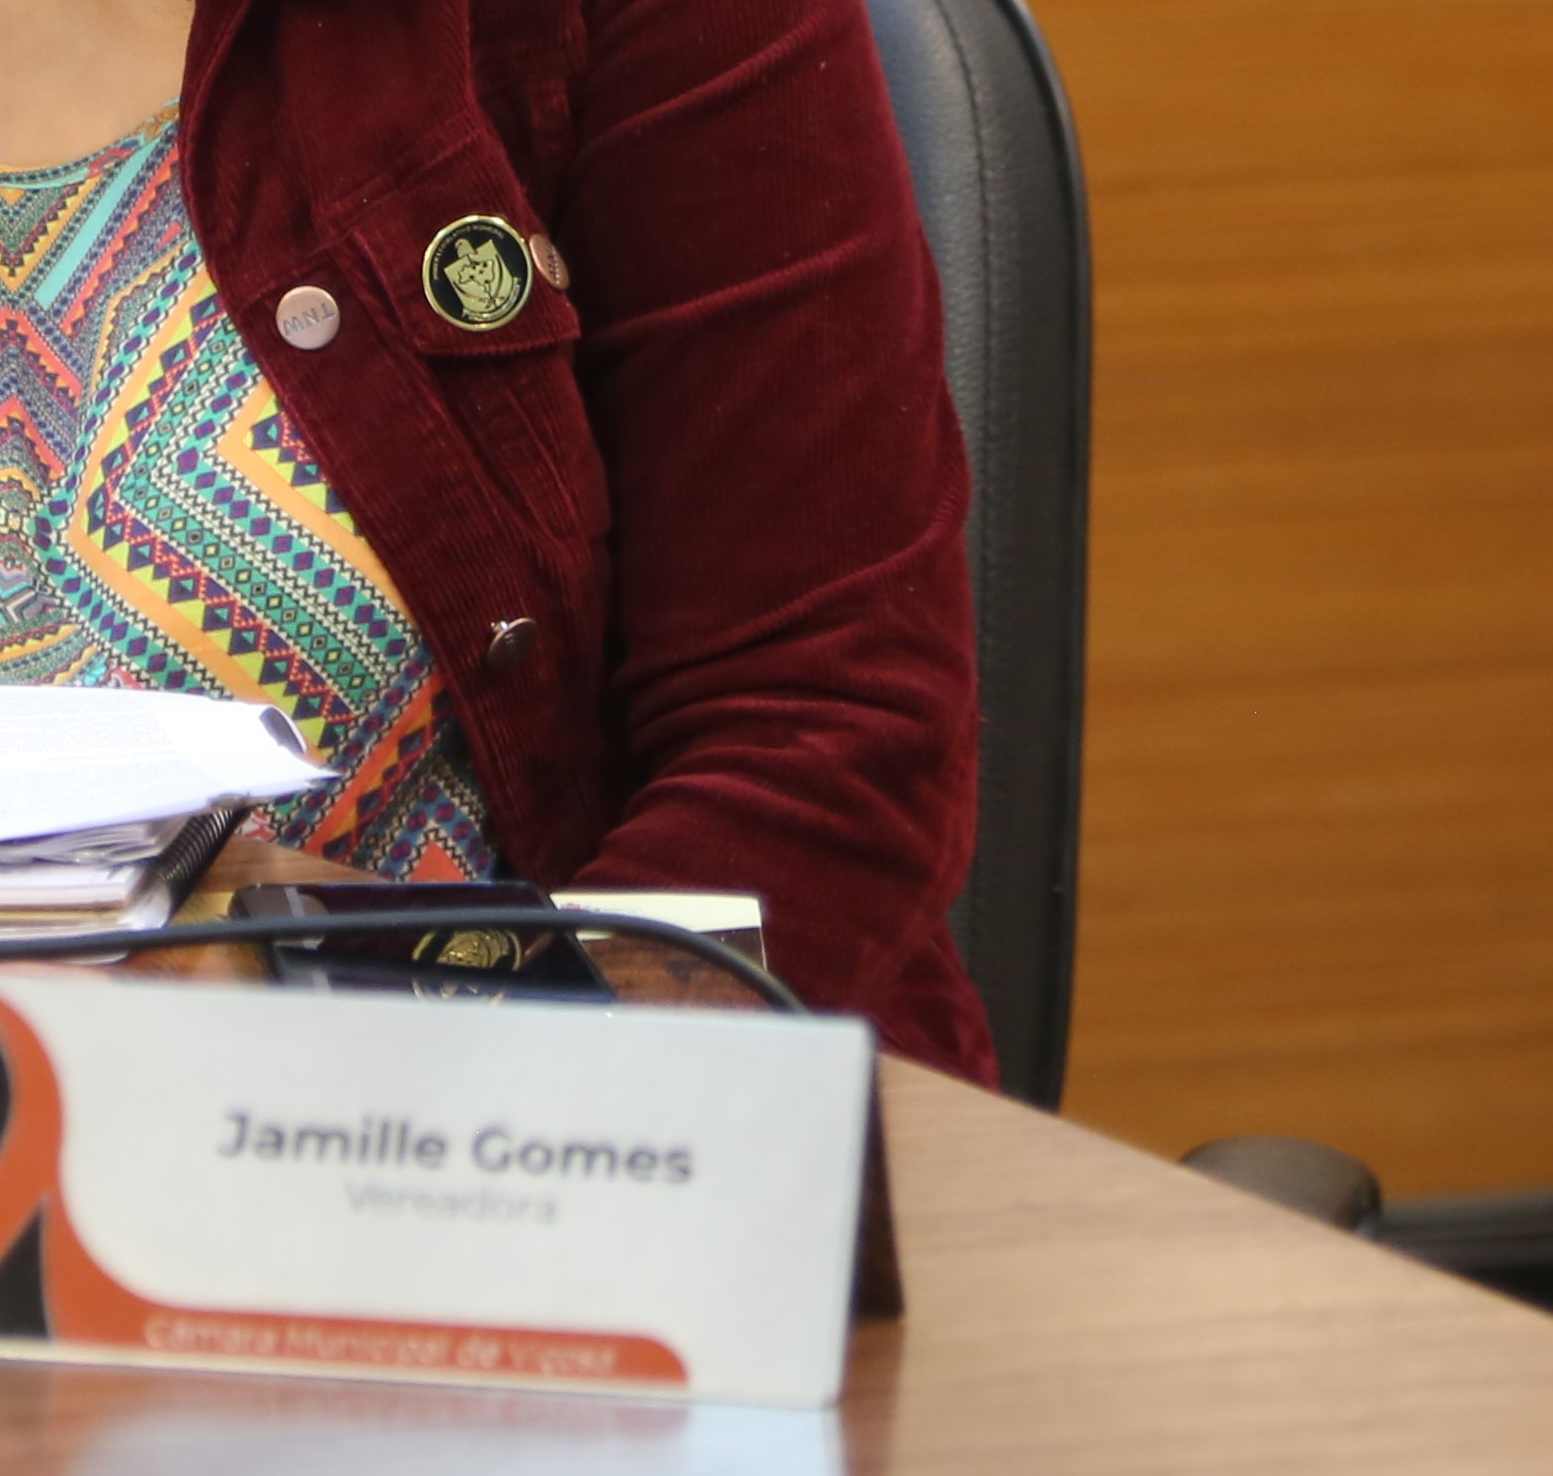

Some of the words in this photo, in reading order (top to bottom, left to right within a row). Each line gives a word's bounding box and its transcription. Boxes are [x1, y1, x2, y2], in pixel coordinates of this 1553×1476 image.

[219, 1109, 447, 1170] Jamille
[472, 1124, 694, 1185] Gomes
[346, 1180, 560, 1223] Vereadora
[456, 1335, 500, 1369] de
